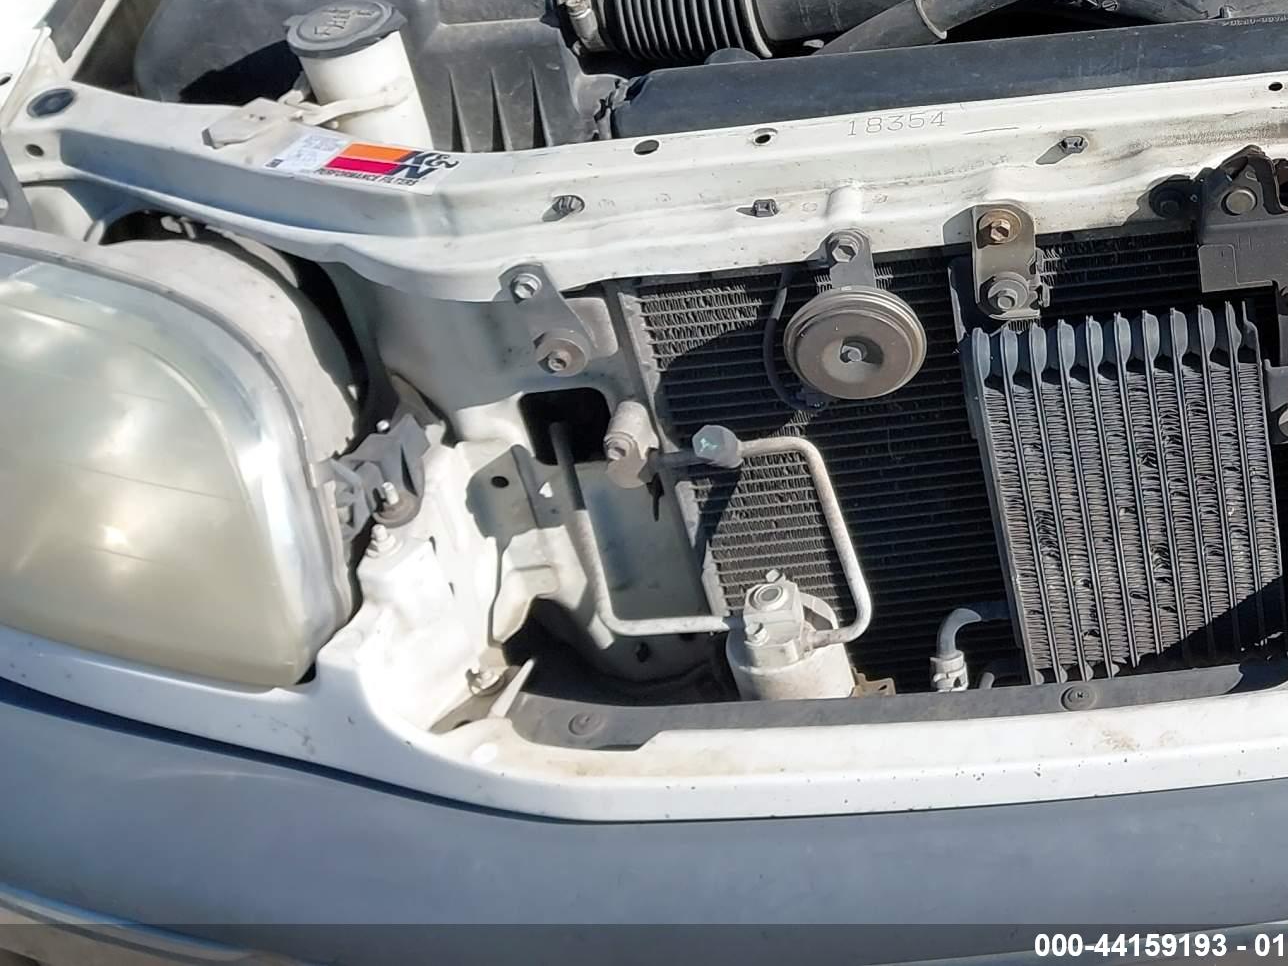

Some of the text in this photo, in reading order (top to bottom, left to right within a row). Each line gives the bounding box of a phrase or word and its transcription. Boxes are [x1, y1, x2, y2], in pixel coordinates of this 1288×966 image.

[847, 111, 945, 136] 18354
[312, 168, 420, 187] PERFORMANCE FILTERS
